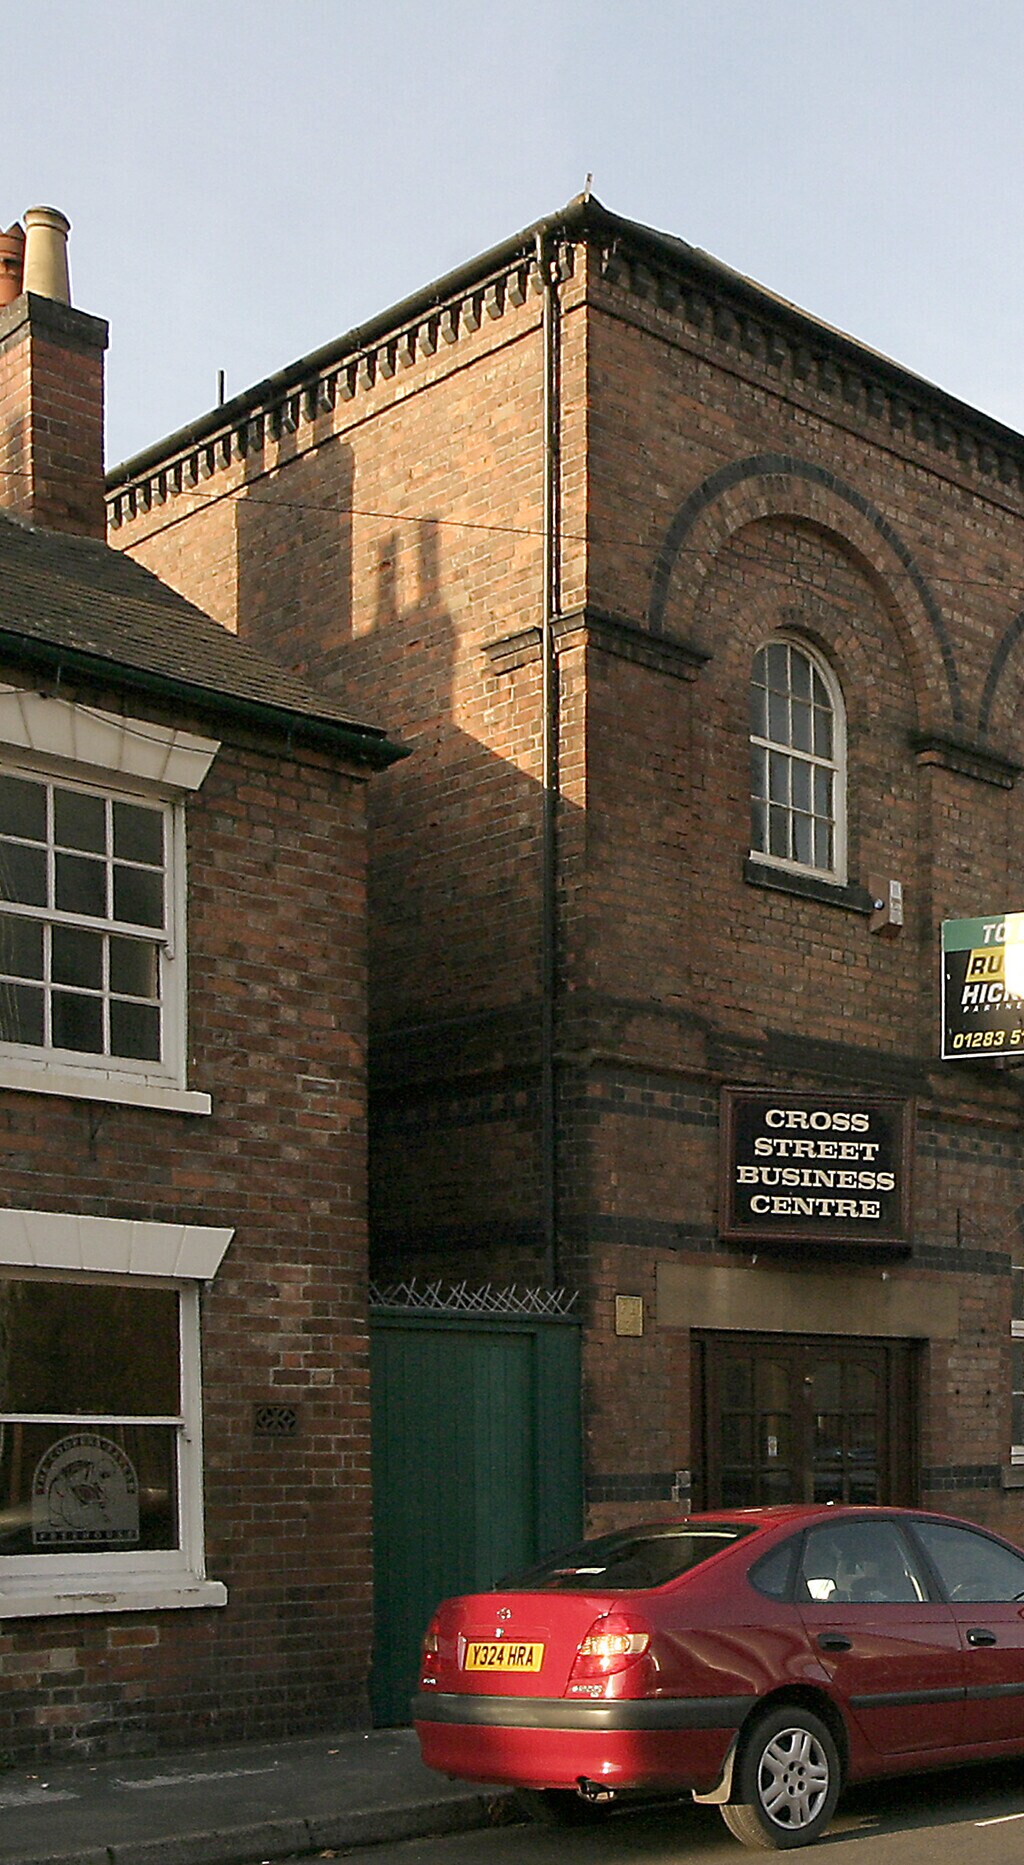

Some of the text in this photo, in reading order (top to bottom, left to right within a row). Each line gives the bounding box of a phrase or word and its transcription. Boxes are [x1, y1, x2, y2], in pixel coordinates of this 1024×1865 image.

[982, 921, 1012, 944] TO
[953, 1030, 1006, 1049] 01283
[765, 1109, 870, 1132] CROSS
[754, 1137, 879, 1161] STREET
[736, 1165, 895, 1191] BUSINESS
[750, 1195, 880, 1218] CENTRE
[473, 1645, 534, 1666] Y324 HRA
